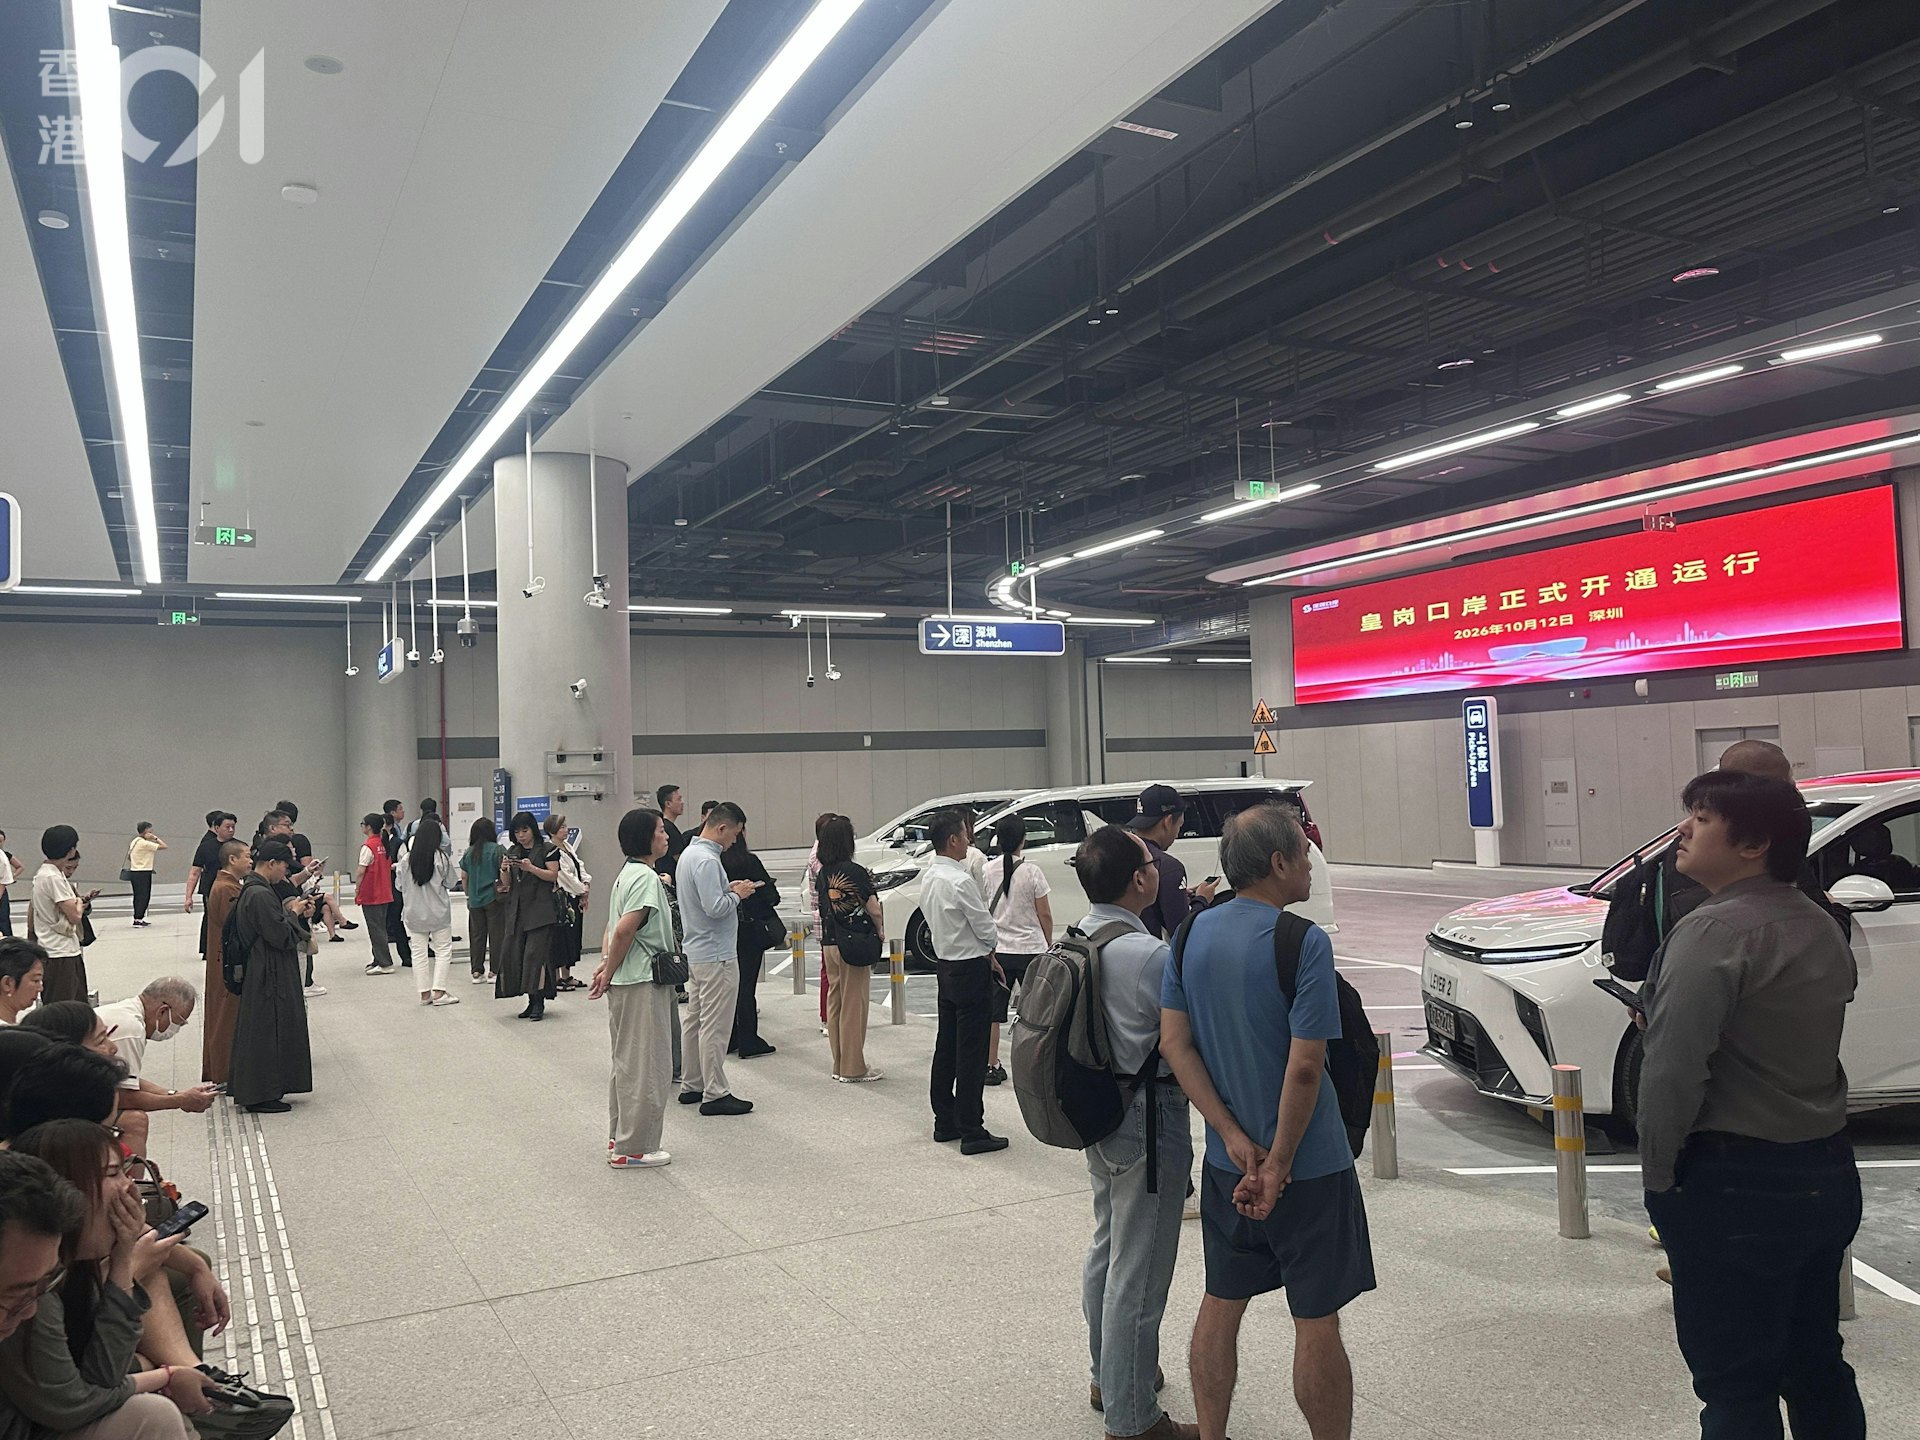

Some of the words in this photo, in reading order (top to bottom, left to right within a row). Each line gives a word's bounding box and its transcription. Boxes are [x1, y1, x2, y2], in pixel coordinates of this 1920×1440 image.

[1360, 551, 1760, 632] 皇岗口岸正式开通运行
[975, 626, 997, 639] 深圳
[1453, 614, 1574, 640] 2026年10月12日
[1588, 607, 1624, 622] 深圳
[975, 639, 1013, 648] Shenzhen
[1744, 674, 1758, 684] EXIT
[1476, 732, 1489, 772] 上客区
[1470, 767, 1478, 787] Area
[1447, 979, 1453, 996] 2
